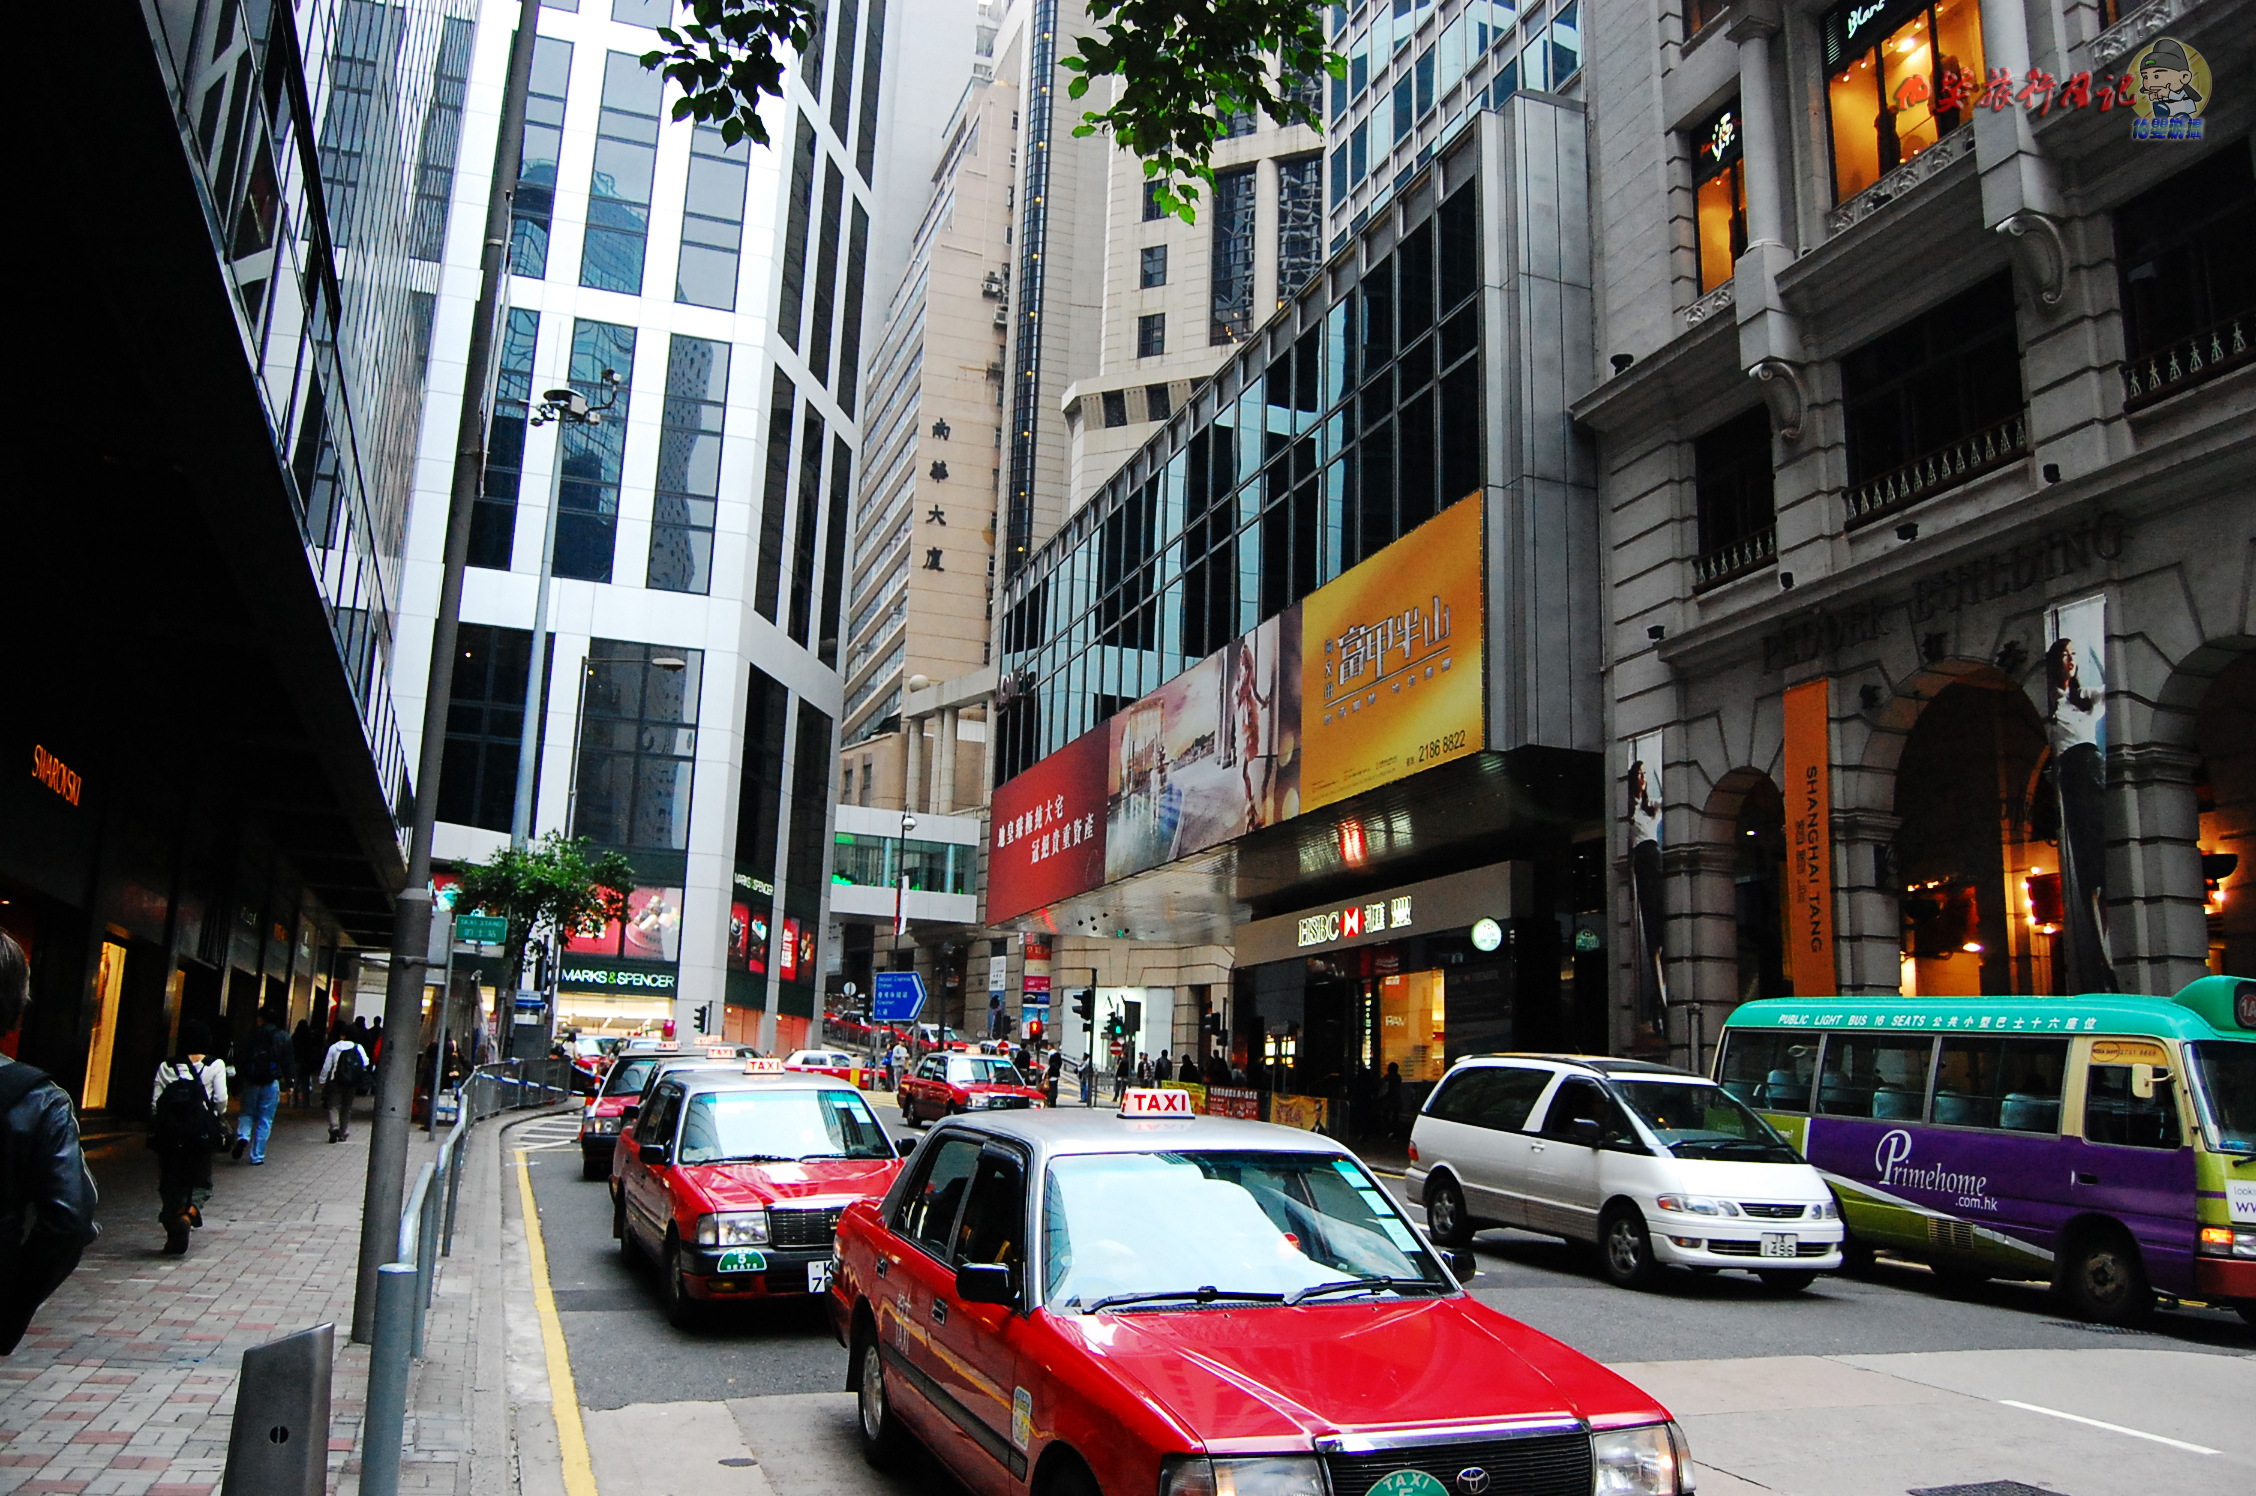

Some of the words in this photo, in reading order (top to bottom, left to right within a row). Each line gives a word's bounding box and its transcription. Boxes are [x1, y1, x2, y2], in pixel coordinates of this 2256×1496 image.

[925, 417, 951, 572] 南華大廈
[1762, 599, 1892, 675] PEDDER
[1911, 511, 2134, 624] BUILDING
[1338, 595, 1450, 686] 富甲半山
[1418, 739, 1441, 763] 2186
[1443, 729, 1466, 753] 8822
[32, 744, 82, 807] SWAROVSKI
[1806, 765, 1821, 884] SHANGHAI
[480, 919, 503, 928] STAND
[1298, 911, 1340, 947] HSBC
[1808, 893, 1822, 953] TANG
[561, 968, 608, 984] MARKS
[608, 971, 617, 985] &
[616, 971, 675, 988] SPENCER
[1777, 1013, 1809, 1026] PUBLIC
[1814, 1014, 1843, 1027] LIGHT
[1848, 1015, 1868, 1027] BUS
[1873, 1015, 1886, 1027] 16
[1891, 1015, 1927, 1028] SEATS
[710, 1048, 734, 1057] TAXI
[749, 1061, 780, 1072] TAXI
[1133, 1094, 1187, 1112] TAXI
[1875, 1129, 1987, 1197] Primehome
[1955, 1196, 1998, 1212] .com.hk
[726, 1262, 758, 1271] SEATS
[737, 1253, 747, 1264] 5
[1382, 1472, 1430, 1492] TAXI
